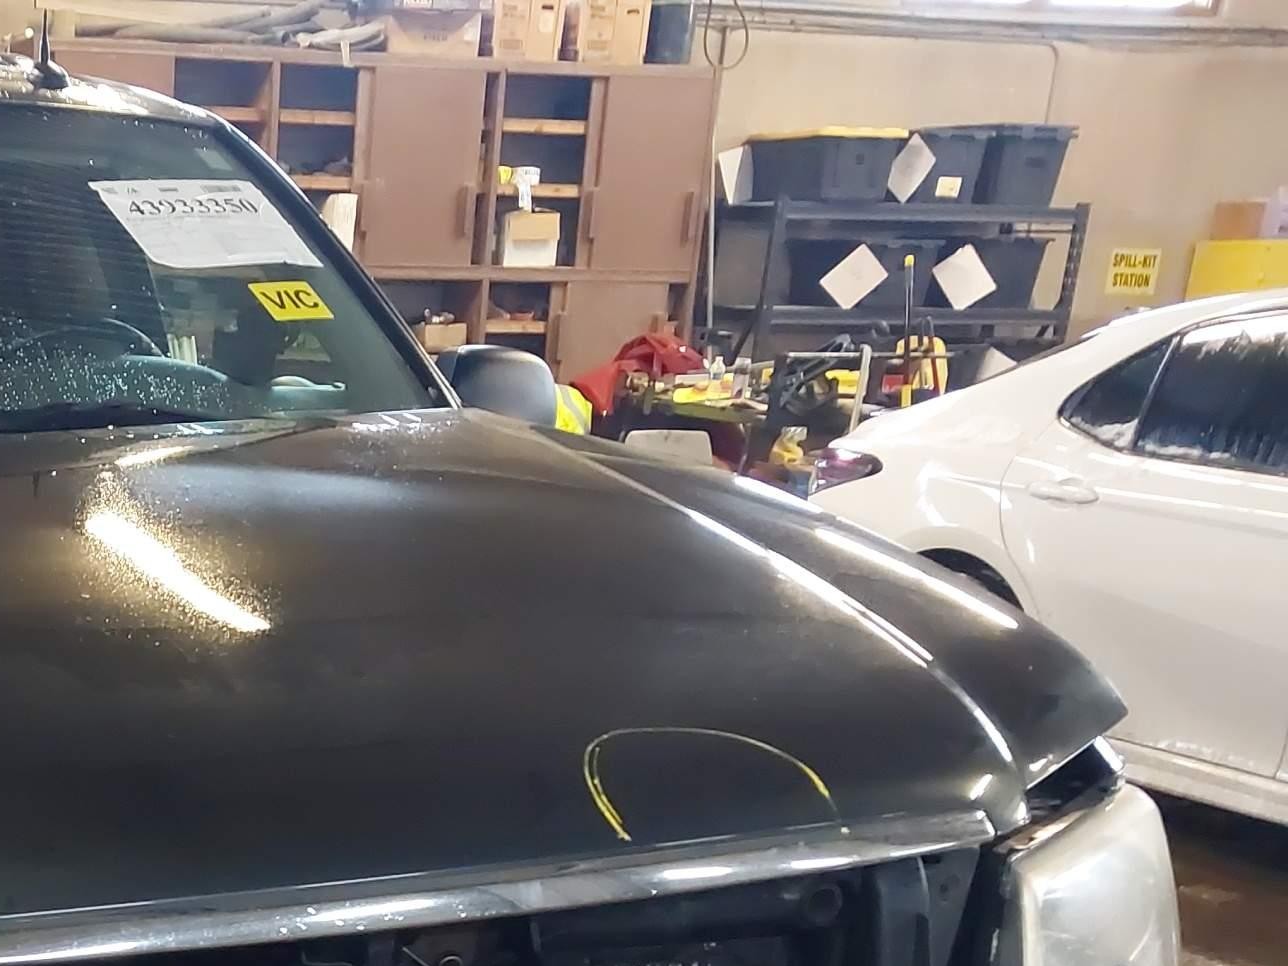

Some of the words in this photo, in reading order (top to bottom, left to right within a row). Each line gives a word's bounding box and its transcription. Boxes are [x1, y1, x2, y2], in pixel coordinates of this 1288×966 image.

[129, 198, 258, 216] 43933350
[1112, 252, 1158, 268] SPILL-KIT
[1112, 271, 1151, 288] STATION
[259, 289, 320, 311] VIC
